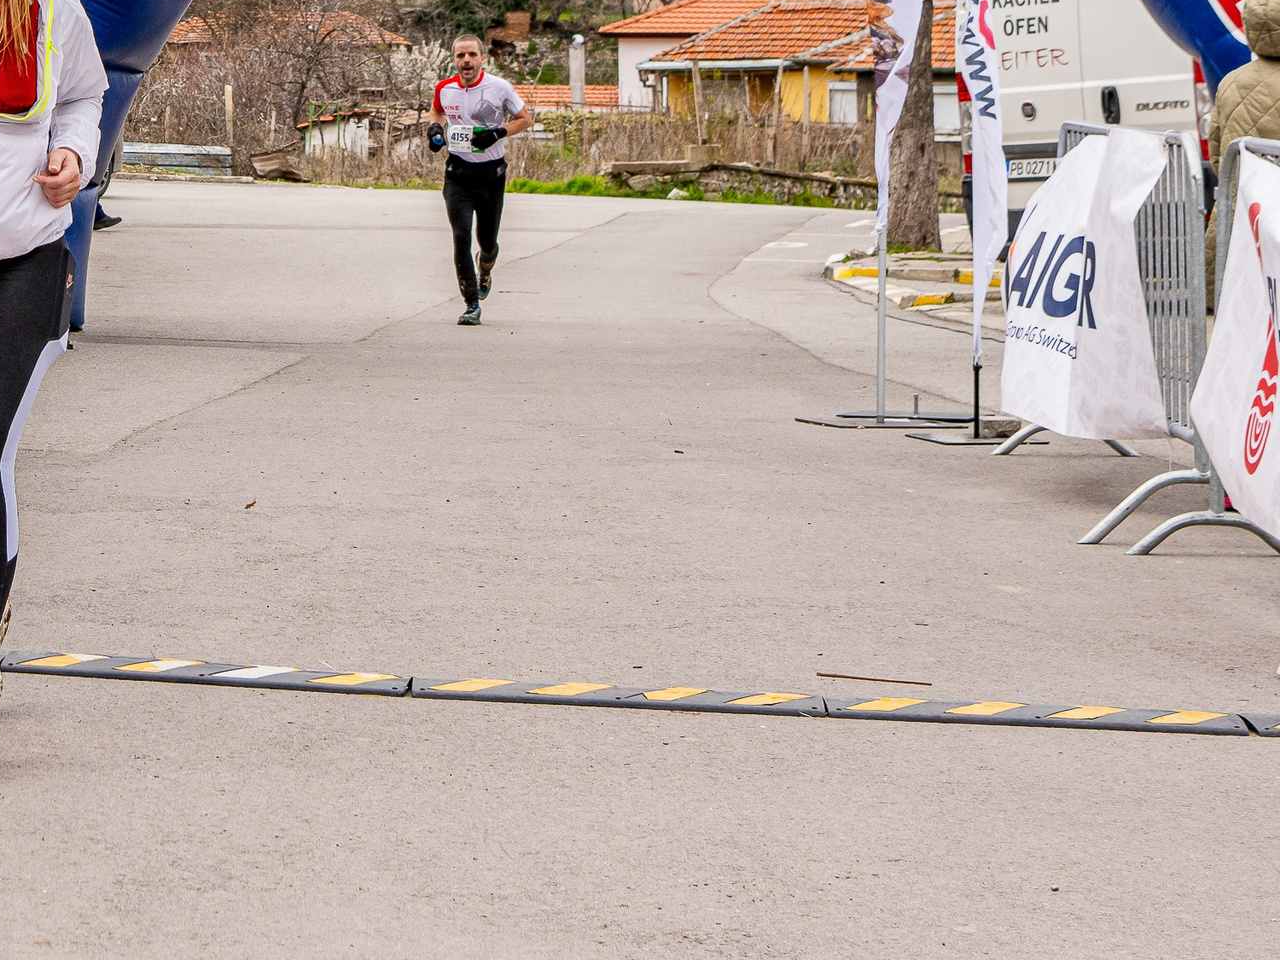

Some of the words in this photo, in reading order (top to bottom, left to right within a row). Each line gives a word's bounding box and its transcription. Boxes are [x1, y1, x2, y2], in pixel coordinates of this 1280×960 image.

[1003, 15, 1049, 36] ÖFEN
[998, 48, 1069, 71] EITER
[1135, 99, 1190, 112] DUCATO
[451, 132, 470, 142] 4155
[1010, 162, 1023, 176] PB
